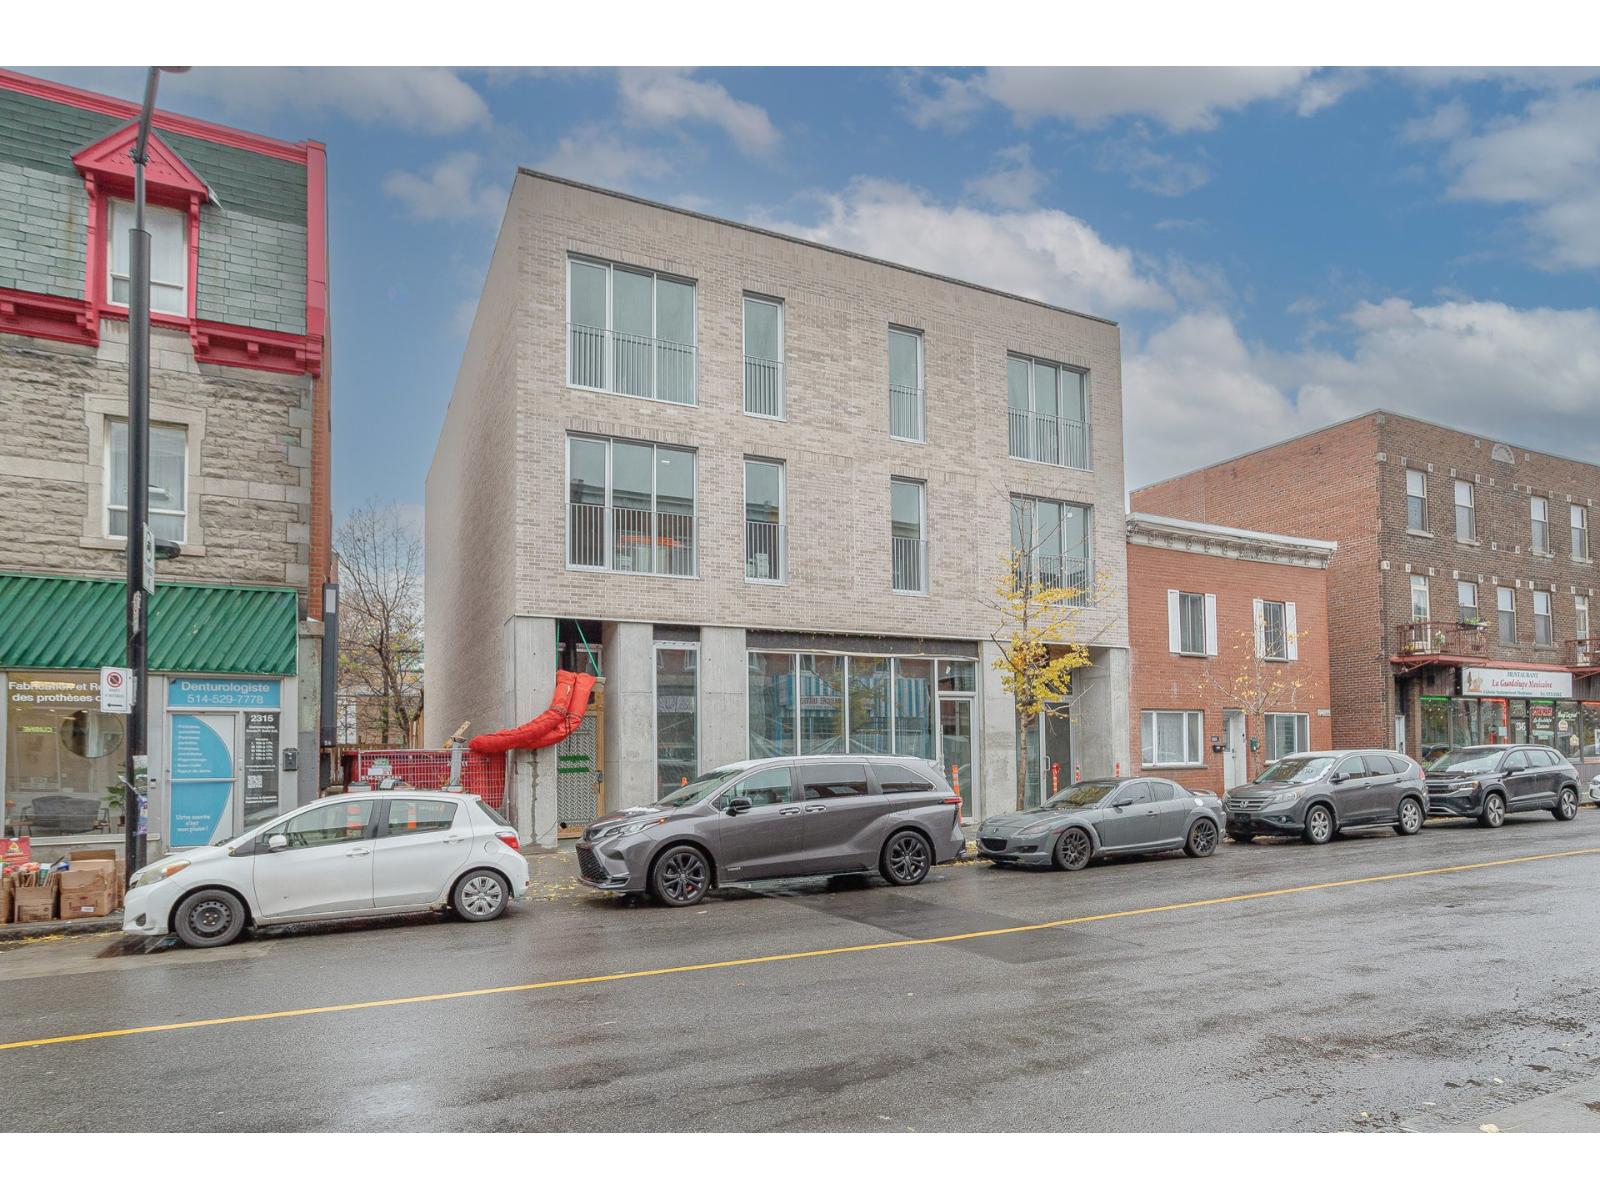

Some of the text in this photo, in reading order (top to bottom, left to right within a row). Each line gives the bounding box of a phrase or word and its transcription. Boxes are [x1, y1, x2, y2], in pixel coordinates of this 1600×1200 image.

[76, 682, 88, 691] et
[181, 681, 270, 694] Denturologiste
[12, 693, 34, 702] des
[36, 693, 93, 703] prothèses
[250, 714, 274, 722] 2315
